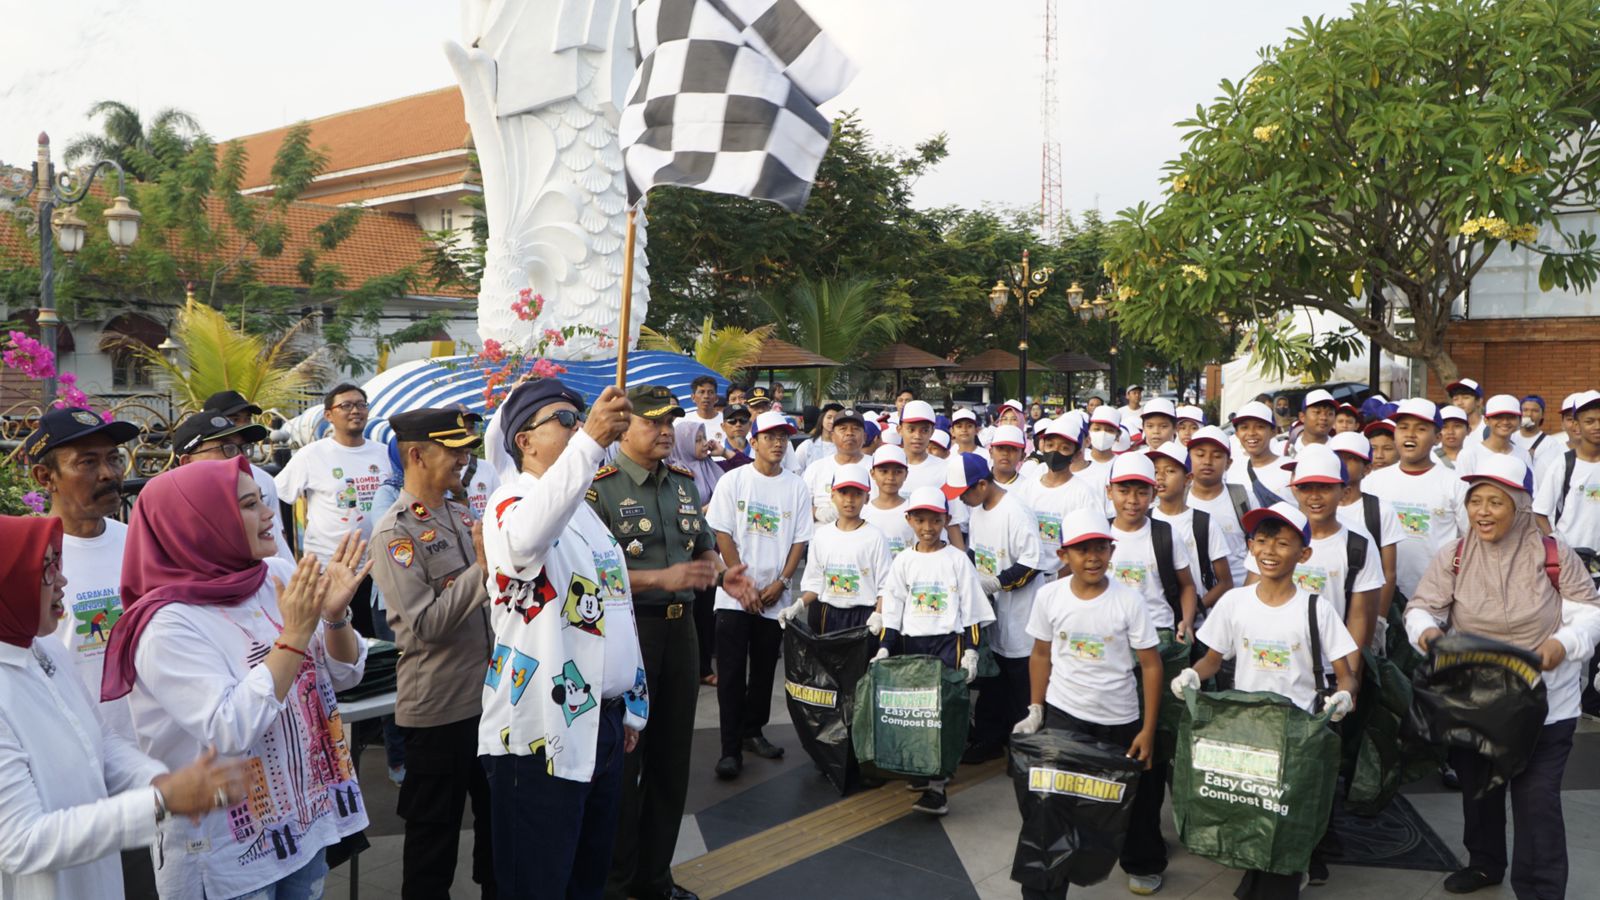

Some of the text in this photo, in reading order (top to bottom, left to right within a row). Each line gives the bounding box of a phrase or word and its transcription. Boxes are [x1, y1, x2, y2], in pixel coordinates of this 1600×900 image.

[355, 476, 380, 484] LOMBA
[356, 483, 379, 491] KREAS
[426, 539, 449, 555] YOGI
[76, 587, 114, 601] GERAKAN
[880, 715, 925, 727] Compost
[911, 709, 940, 719] Grow
[1031, 769, 1122, 800] AN ORGANIK
[1204, 771, 1284, 799] Easy Grow
[1199, 785, 1289, 816] Compost Bag
